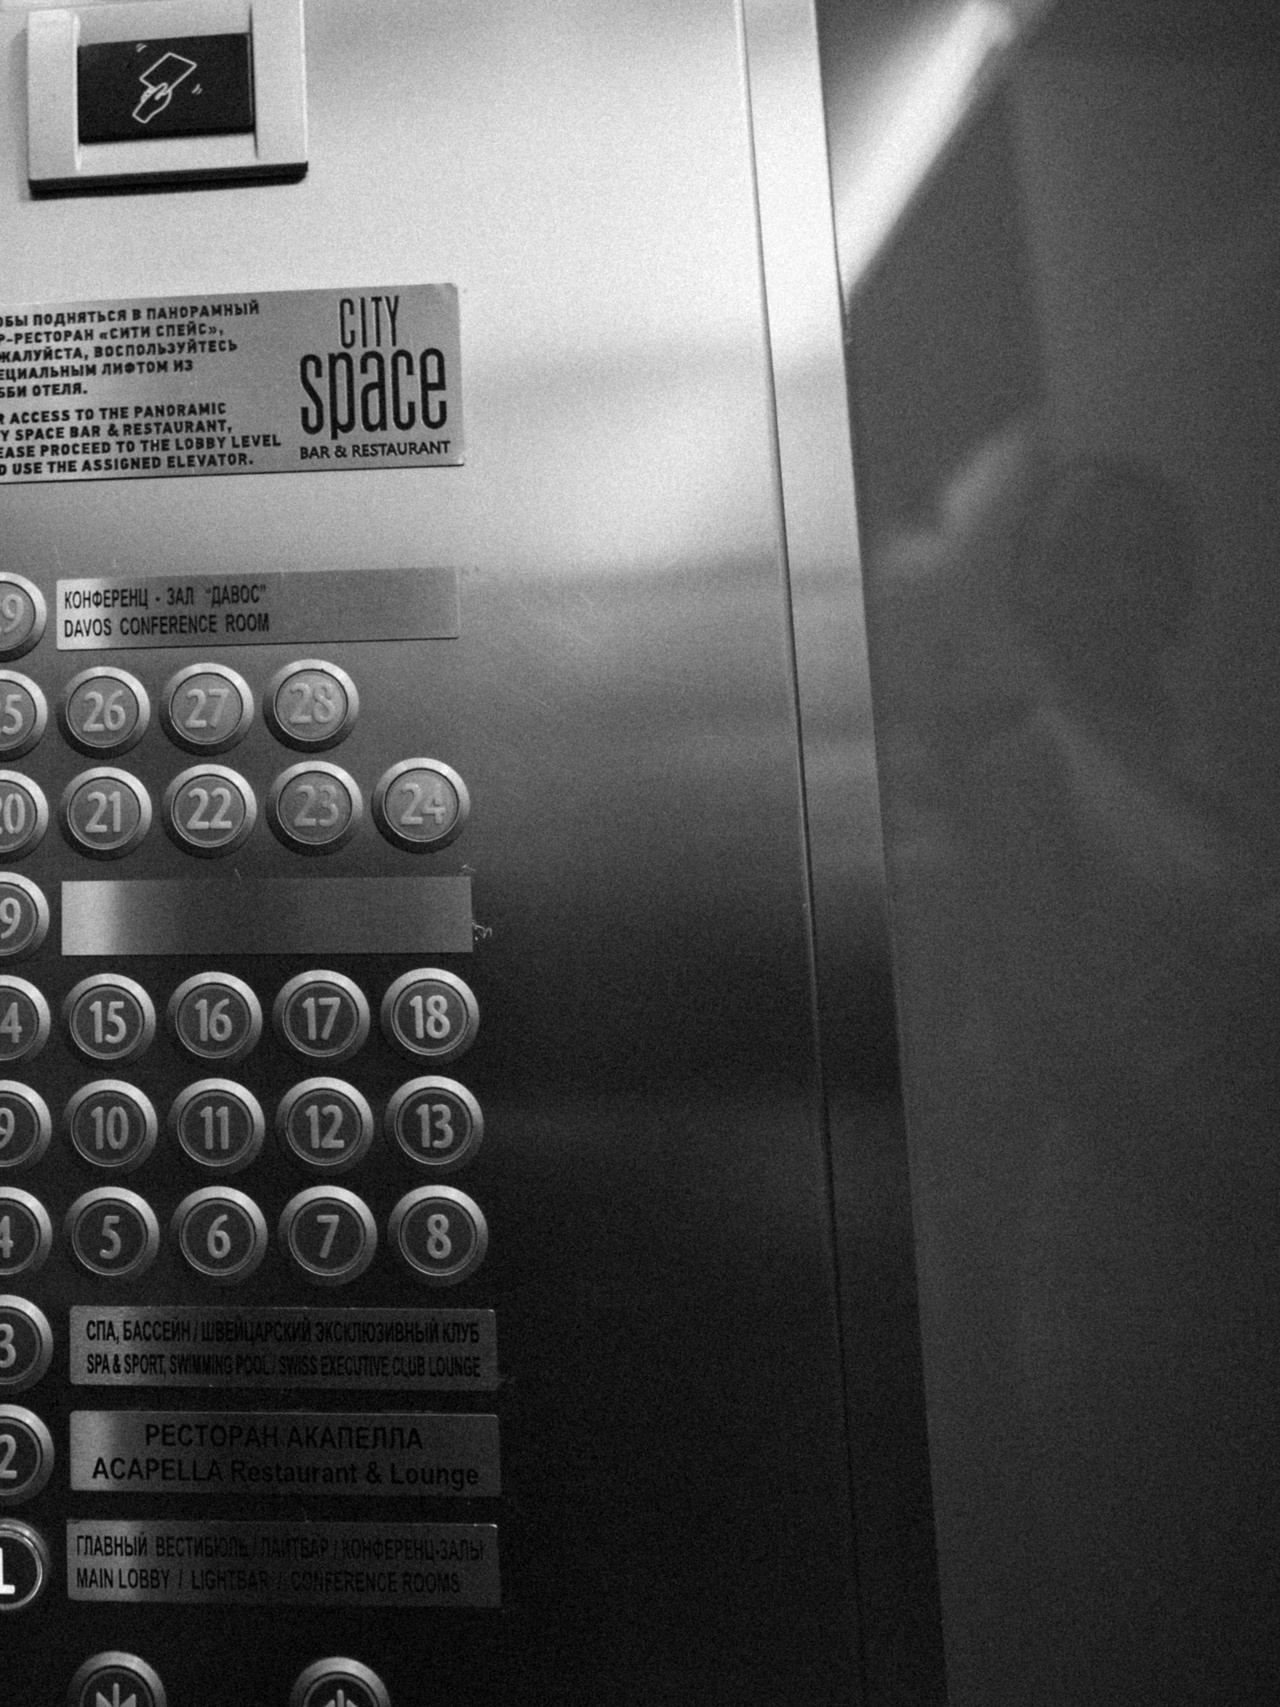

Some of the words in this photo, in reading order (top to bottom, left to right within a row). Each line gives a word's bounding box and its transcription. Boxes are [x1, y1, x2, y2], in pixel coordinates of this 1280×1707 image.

[34, 309, 126, 326] ПОДНЯТЬСЯ
[132, 309, 141, 320] В
[147, 299, 259, 320] ПАНОРАМНЫЙ
[339, 295, 399, 349] CITY
[94, 339, 238, 358] ВОСПОЛЬЗУЙТЕСЬ
[102, 361, 168, 375] ЛИФТОМ
[173, 359, 194, 372] ИЗ
[32, 382, 88, 397] ОТЕЛЯ.
[300, 347, 447, 440] space
[10, 409, 70, 424] ACCESS
[75, 408, 94, 421] TO
[99, 407, 129, 420] THE
[134, 402, 226, 418] PANORAMIC
[15, 427, 65, 441] SPACE
[70, 425, 101, 438] BAR
[107, 424, 118, 437] &
[123, 419, 232, 436] RESTAURANT,
[12, 462, 42, 476] USE
[47, 460, 77, 474] THE
[81, 456, 161, 472] ASSIGNED
[167, 453, 253, 469] ELEVATOR.
[40, 442, 111, 457] PROCEED
[116, 441, 135, 453] TO
[140, 439, 170, 452] THE
[175, 437, 226, 451] LOBBY
[231, 434, 281, 449] LEVEL
[300, 446, 330, 460] BAR
[334, 445, 347, 459] &
[352, 440, 450, 457] RESTAURANT
[64, 588, 148, 610] КОНФЕРЕНЦ
[167, 586, 194, 605] ЗАЛ
[64, 618, 112, 638] DAVOS
[120, 614, 217, 635] CONFERENCE
[225, 612, 270, 633] ROOM
[83, 690, 125, 732] 26
[185, 688, 229, 728] 27
[288, 682, 335, 724] 28
[85, 790, 121, 832] 21
[186, 787, 232, 829] 22
[293, 784, 339, 827] 23
[400, 782, 446, 825] 24
[89, 1000, 127, 1044] 15
[195, 998, 232, 1042] 16
[302, 996, 341, 1041] 17
[409, 994, 451, 1039] 18
[91, 1105, 129, 1150] 10
[199, 1105, 229, 1150] 11
[305, 1104, 344, 1149] 12
[416, 1103, 453, 1148] 13
[99, 1215, 121, 1259] 5
[207, 1214, 231, 1258] 6
[317, 1214, 340, 1258] 7
[426, 1213, 451, 1259] 8
[86, 1320, 119, 1344] СПА,
[123, 1317, 191, 1341] БАССЕЙН
[201, 1315, 311, 1346] ШВЕЙЦАРСКИЙ
[315, 1317, 438, 1343] ЭКСКЛЮЗИВНЫЙ
[442, 1322, 479, 1343] КЛУБ
[87, 1354, 110, 1373] SPA
[113, 1354, 120, 1373] &
[124, 1354, 166, 1377] SPORT,
[170, 1354, 233, 1375] SWIMMING
[235, 1355, 270, 1375] POOL
[278, 1355, 318, 1375] SWISS
[321, 1355, 389, 1376] EXECUTIVE
[392, 1356, 425, 1376] CLUB
[429, 1356, 481, 1377] LOUNGE
[145, 1424, 278, 1448] РЕСТОРАН
[287, 1426, 422, 1450] АКАПЕЛЛА
[93, 1458, 222, 1481] ACAPELLA
[231, 1460, 358, 1484] Restaurant
[365, 1461, 381, 1484] &
[391, 1462, 479, 1489] Lounge
[76, 1532, 148, 1556] ГЛАВНЫЙ
[156, 1535, 249, 1558] ВЕСТИБЮЛЬ
[76, 1568, 114, 1588] MAIN
[119, 1568, 170, 1589] LOBBY
[191, 1569, 270, 1591] LIGHTBAR
[290, 1571, 398, 1593] CONFERENCE
[403, 1572, 460, 1594] ROOMS
